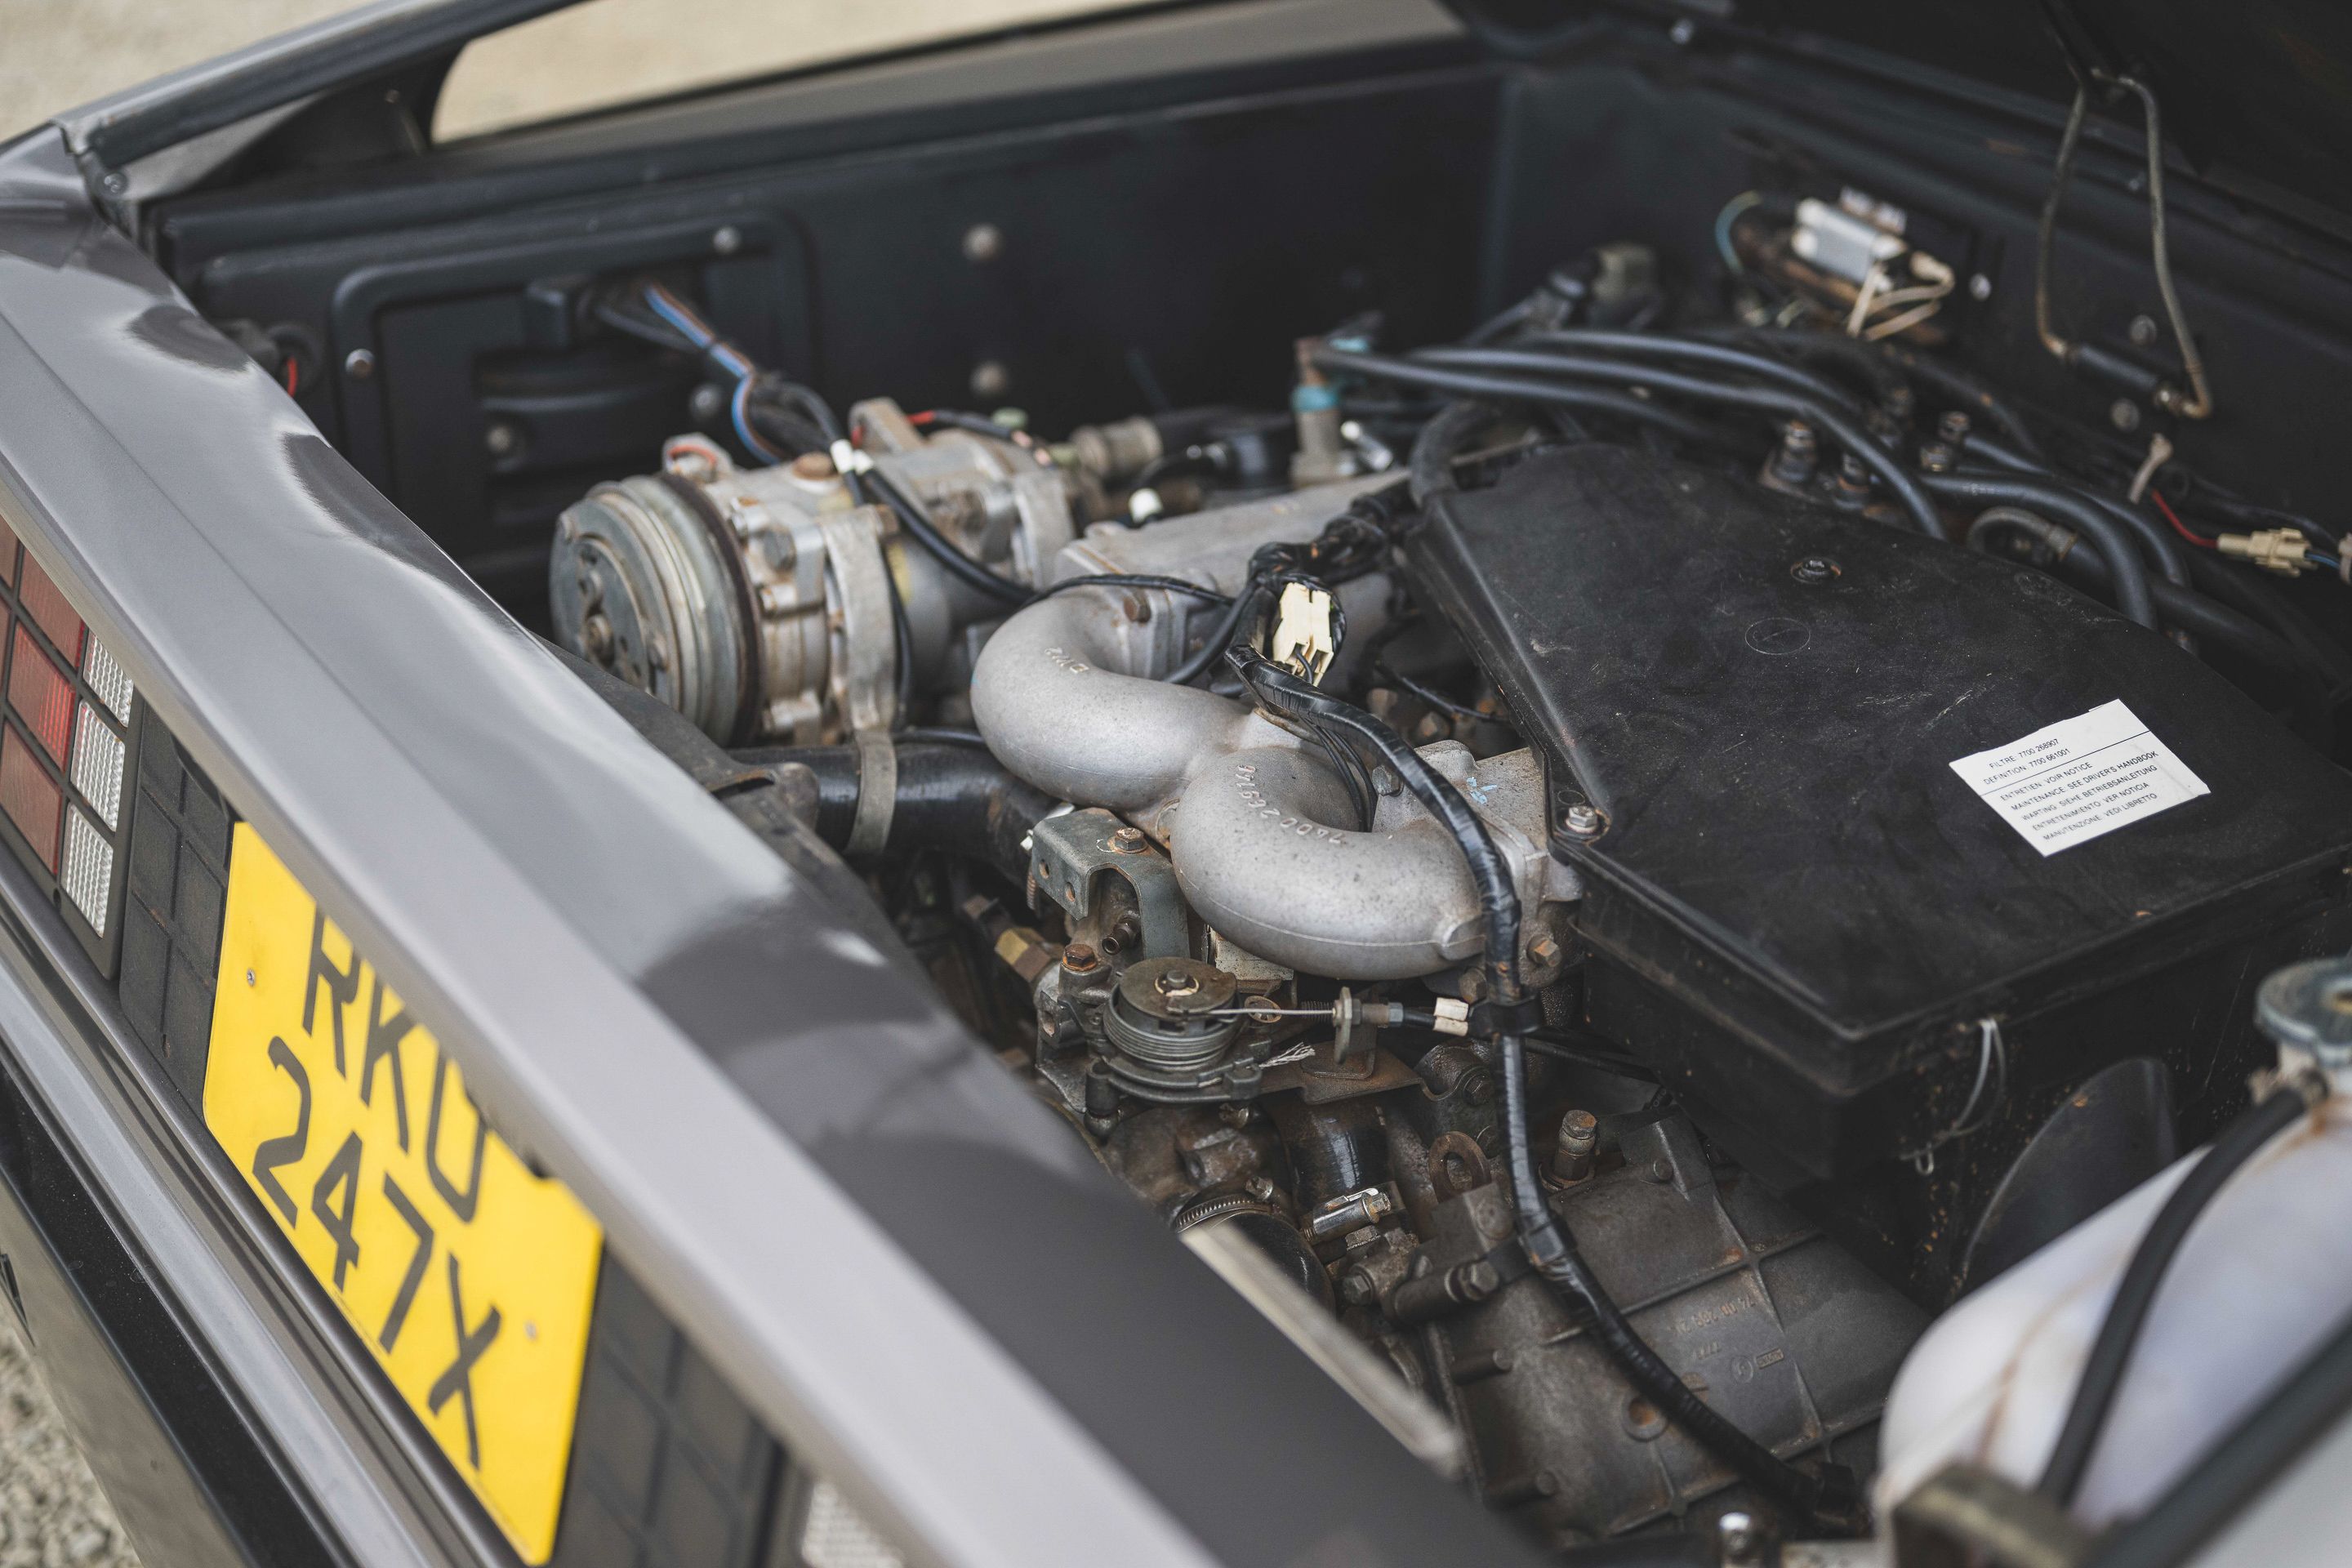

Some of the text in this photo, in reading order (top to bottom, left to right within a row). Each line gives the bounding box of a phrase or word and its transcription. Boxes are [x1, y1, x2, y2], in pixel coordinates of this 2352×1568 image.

[2018, 748, 2036, 759] 7700
[2037, 738, 2059, 752] 268907
[2029, 758, 2046, 768] 7700
[2046, 748, 2071, 761] 661001
[2045, 773, 2064, 785] VOIR
[2065, 762, 2093, 777] NOTICE
[2067, 779, 2084, 790] SEE
[2084, 766, 2118, 784] DRIVER'S
[2118, 751, 2158, 771] HANDBOOK
[2058, 794, 2082, 808] SIEHE
[2082, 764, 2158, 798] BETRIEBSANLEITUNG
[2104, 793, 2119, 804] VER
[2118, 782, 2149, 798] NOTICIA
[2105, 805, 2123, 817] VEDI
[2123, 793, 2158, 810] LIBRETTO
[252, 1036, 502, 1470] 247X
